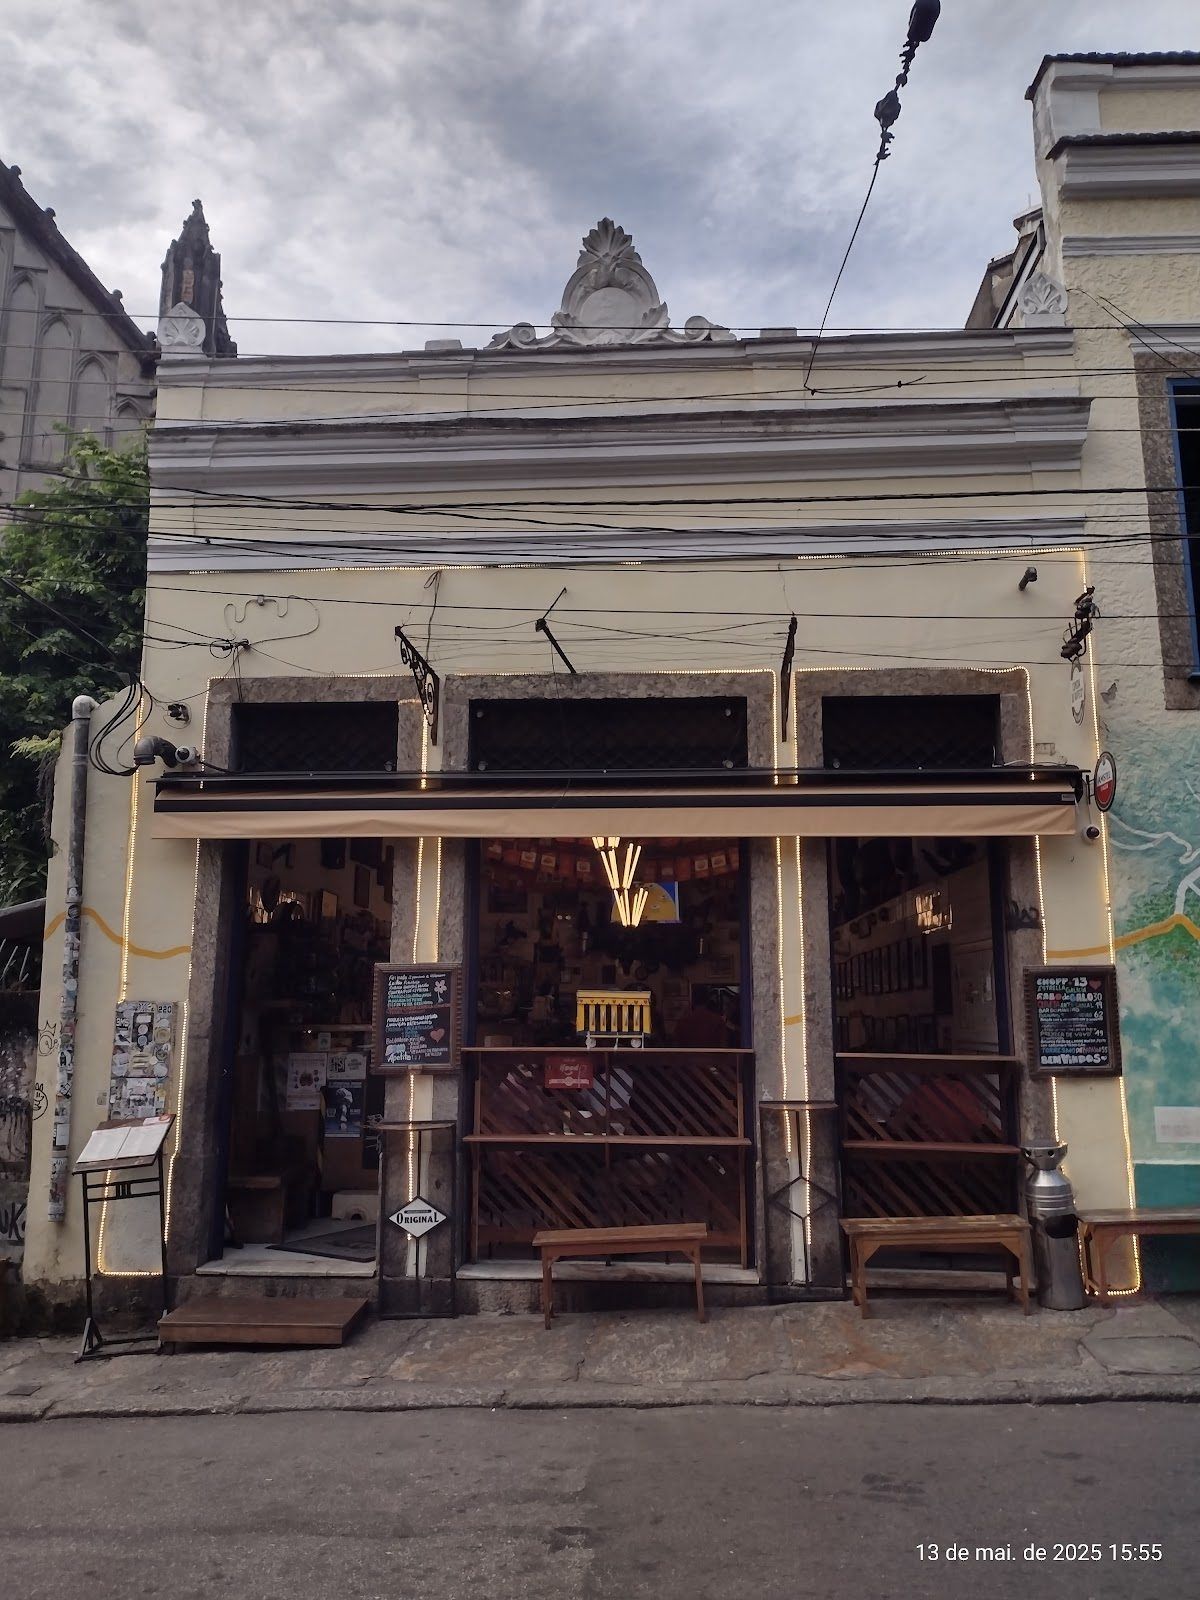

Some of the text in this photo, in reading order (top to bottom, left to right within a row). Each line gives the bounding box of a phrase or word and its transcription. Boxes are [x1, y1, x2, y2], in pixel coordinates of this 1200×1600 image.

[1036, 977, 1088, 986] CHOPP 13
[1093, 992, 1102, 1001] 30
[396, 1212, 440, 1224] ORIGINAL
